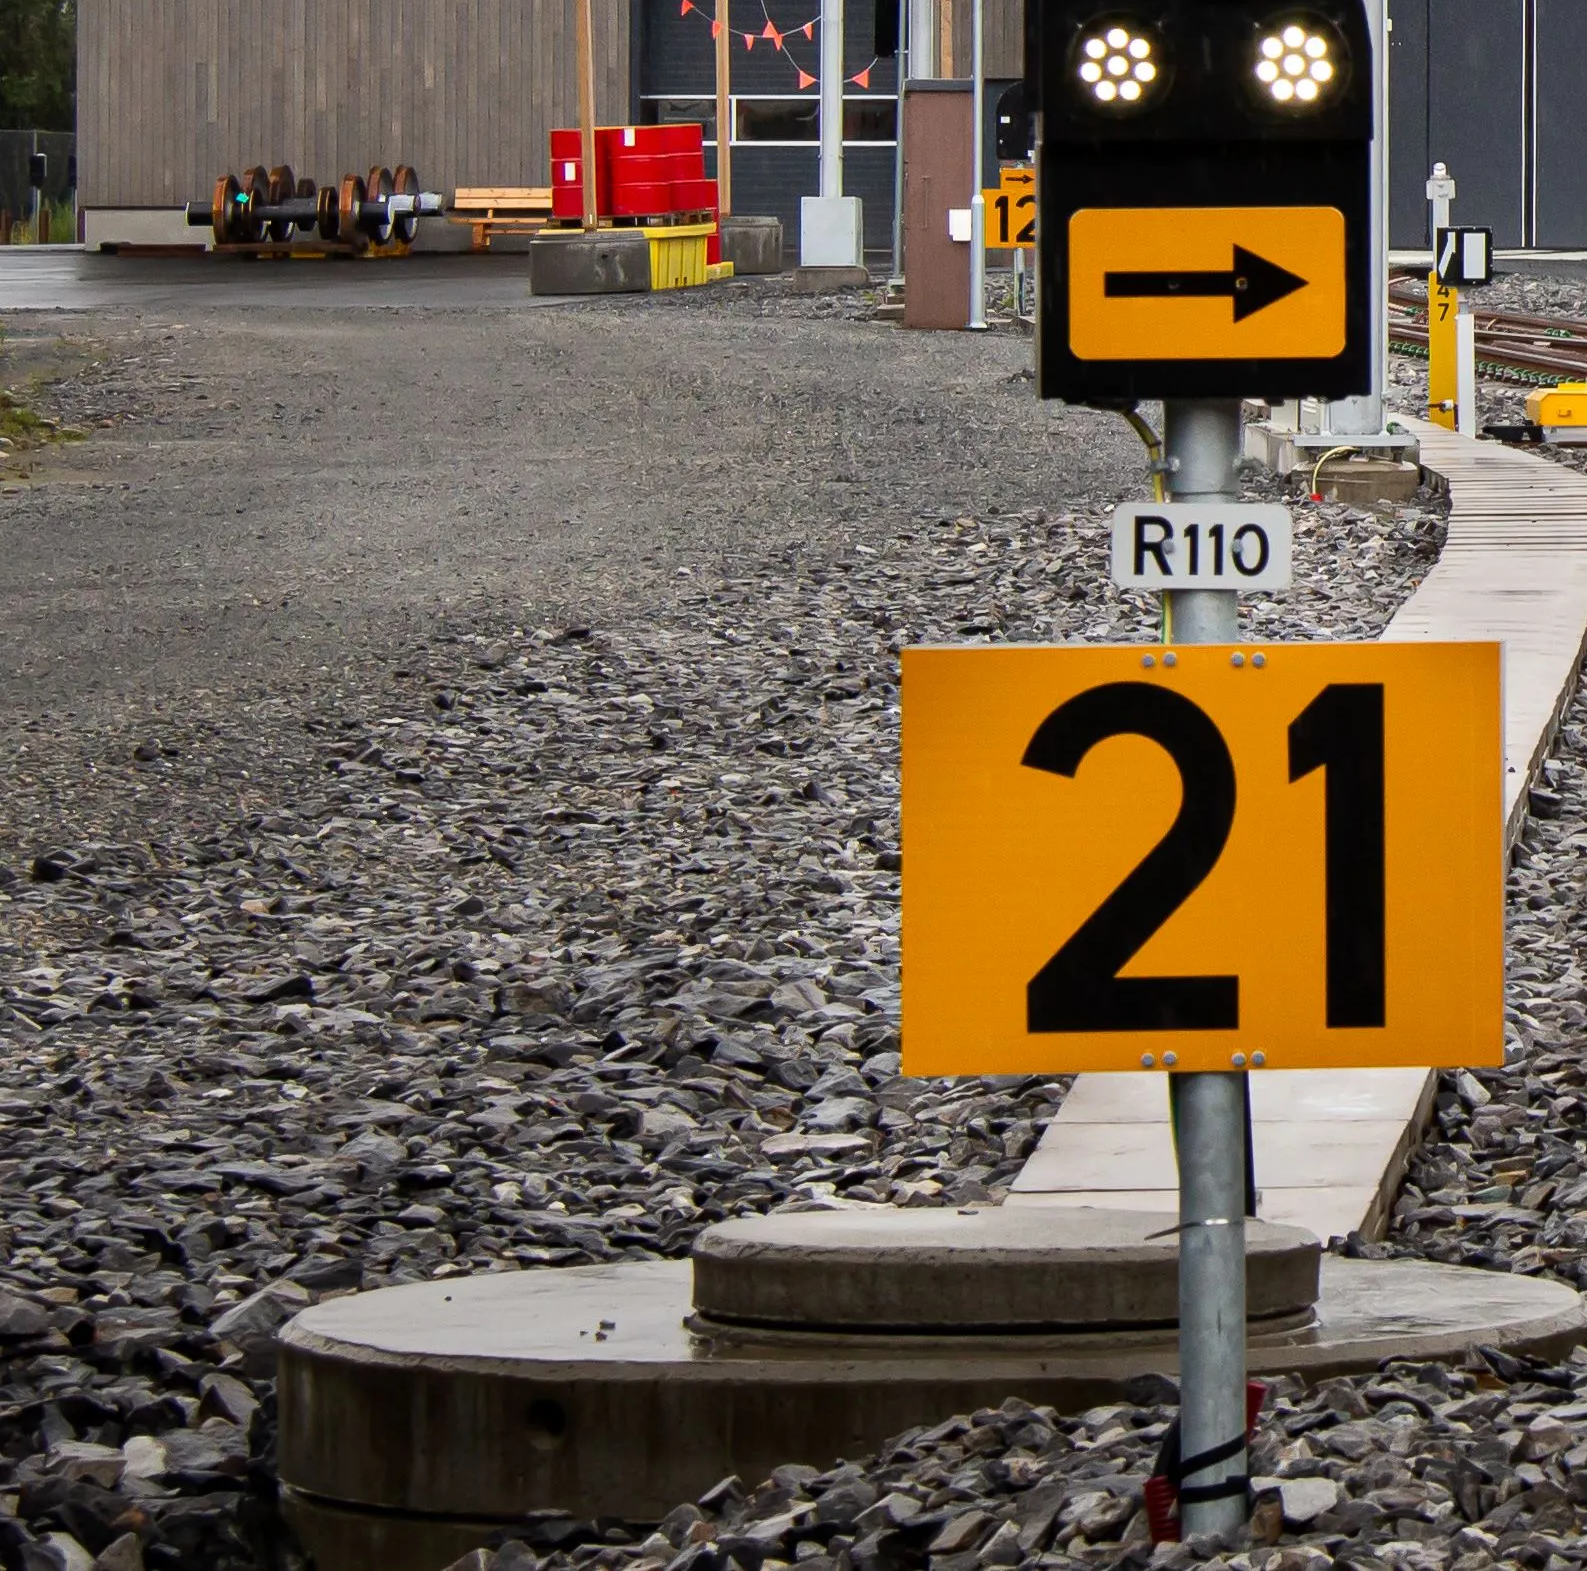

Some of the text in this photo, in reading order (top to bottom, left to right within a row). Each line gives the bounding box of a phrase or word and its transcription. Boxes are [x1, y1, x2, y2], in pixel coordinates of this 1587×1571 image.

[994, 194, 1037, 243] 12
[1133, 515, 1270, 577] R110
[1021, 680, 1386, 1034] 21
